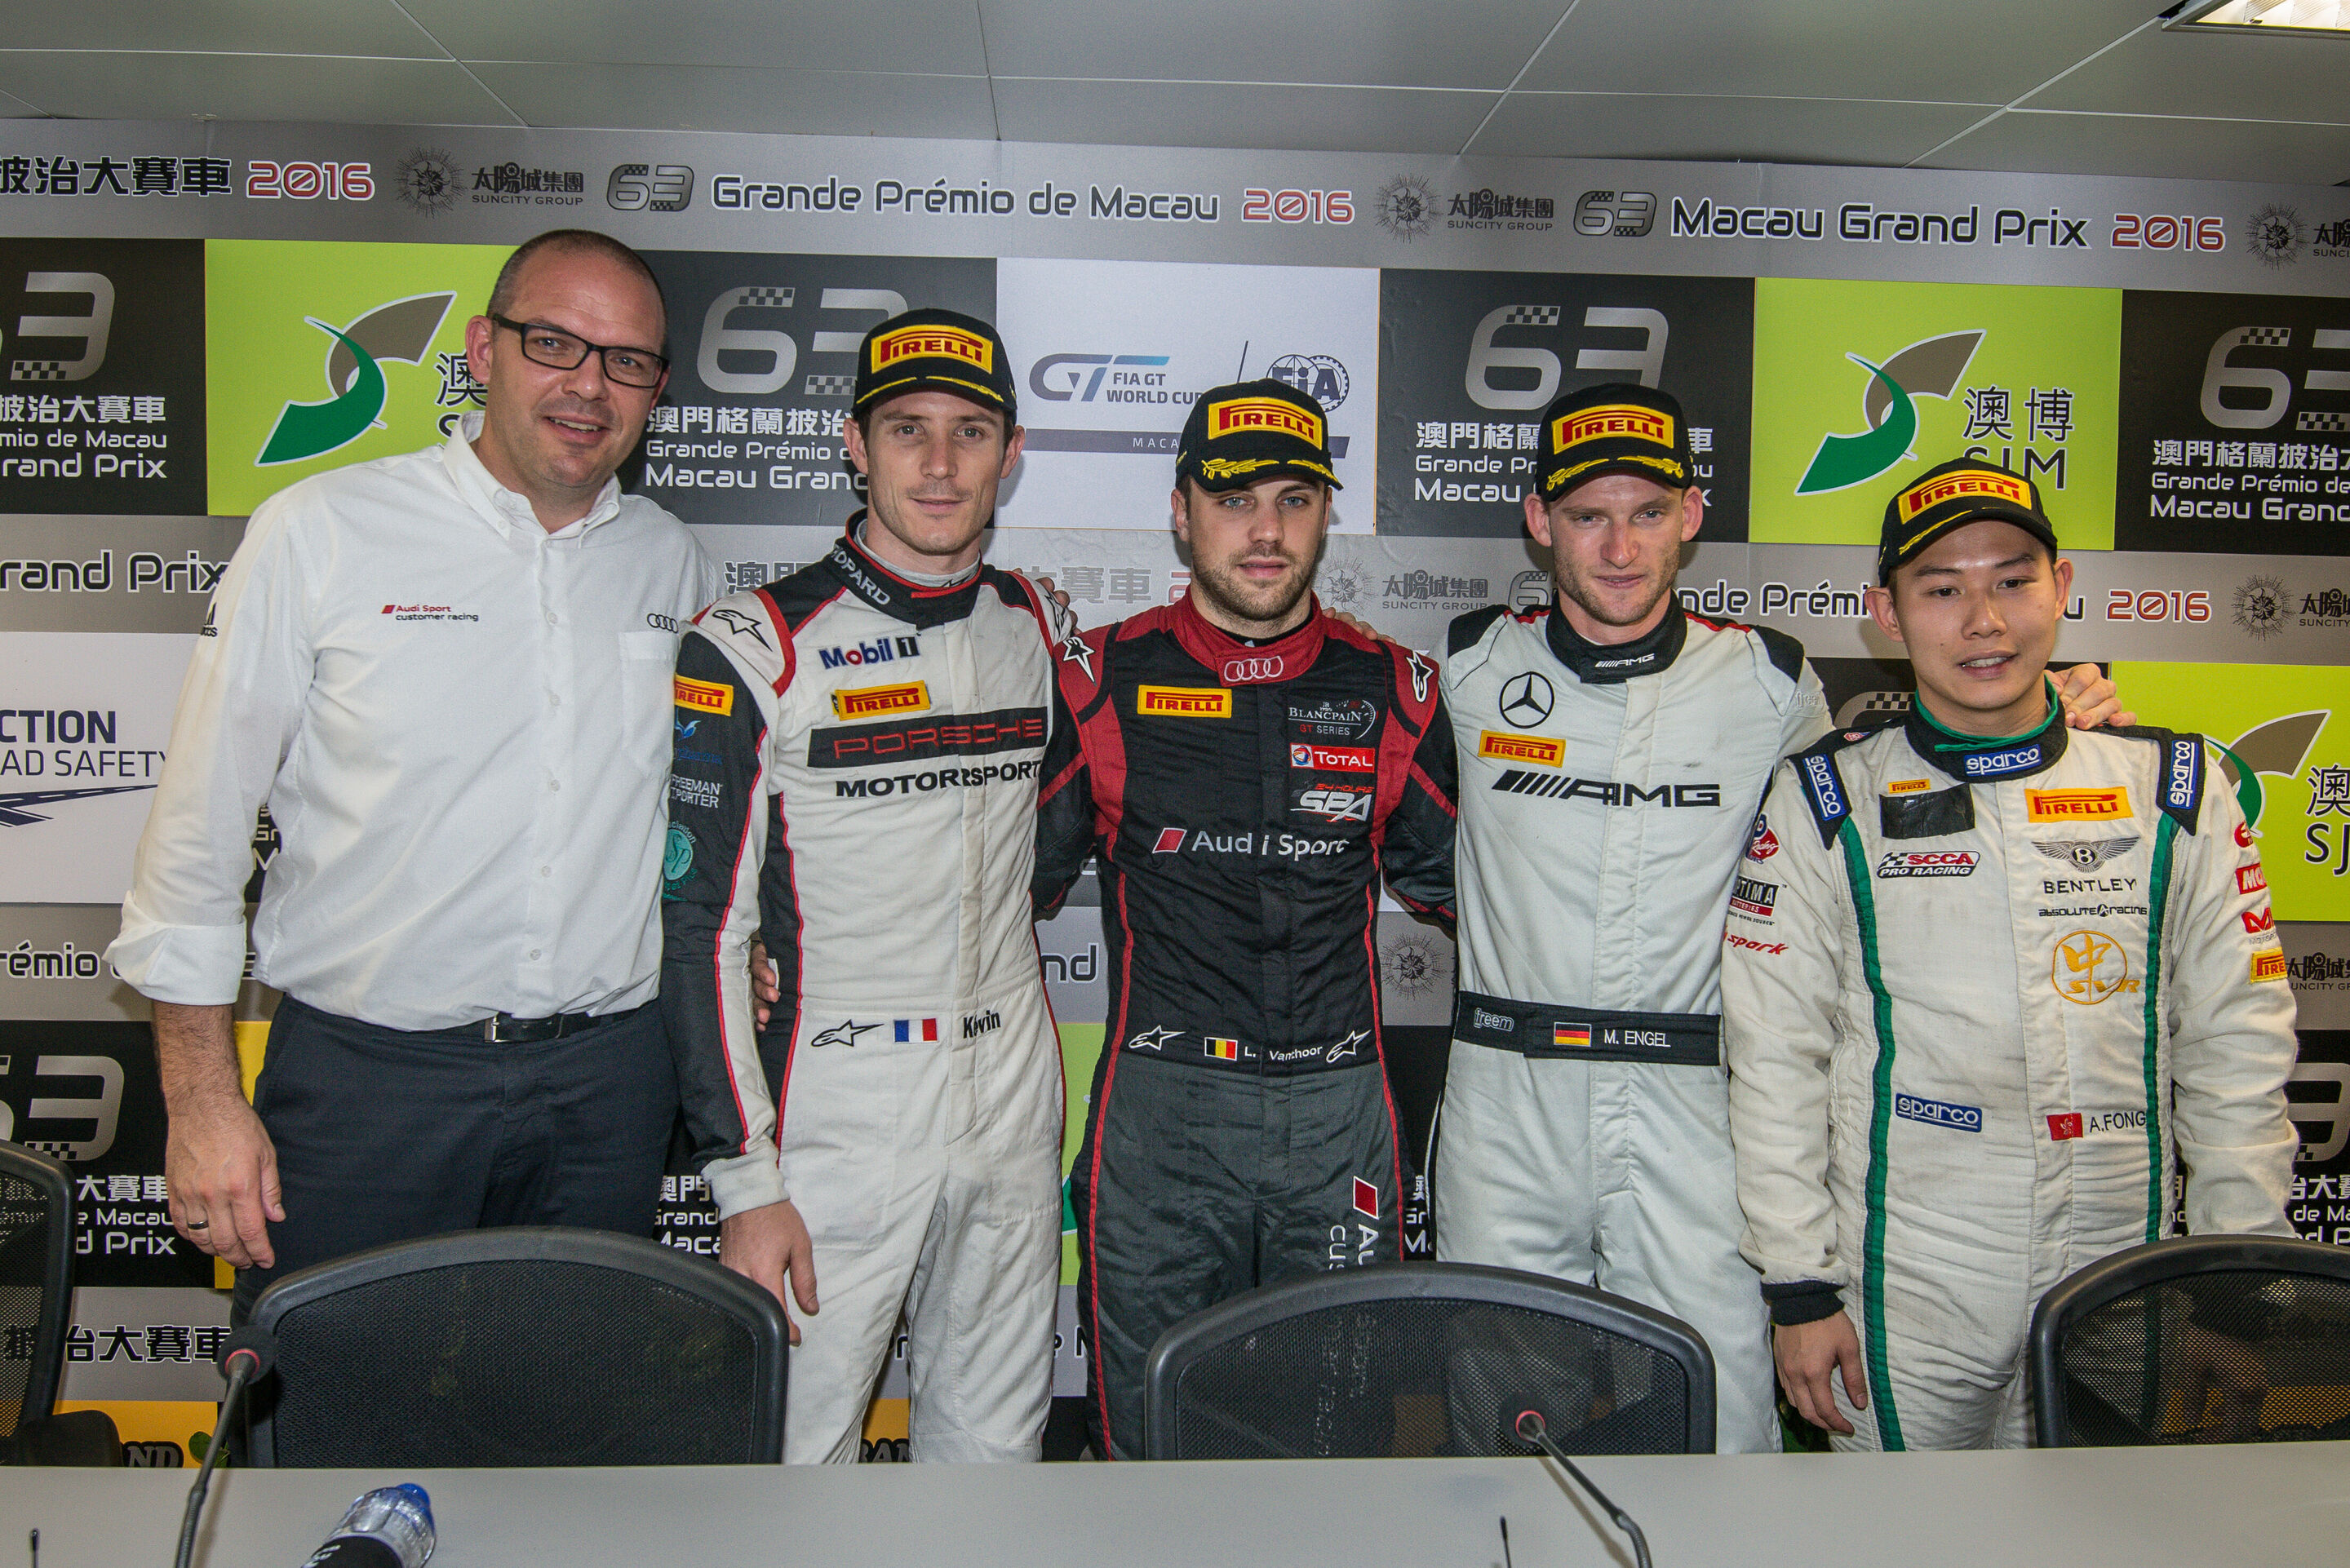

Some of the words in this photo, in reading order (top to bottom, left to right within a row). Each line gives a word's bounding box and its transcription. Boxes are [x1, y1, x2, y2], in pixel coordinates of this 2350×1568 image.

[246, 162, 375, 201] 2016
[606, 164, 694, 212] 63
[472, 195, 531, 206] SUNCITY
[535, 196, 584, 206] GROUP
[712, 175, 862, 214] Grande
[875, 177, 1015, 215] Prémio
[1028, 181, 1077, 218] de
[1090, 185, 1221, 222] Macau
[1242, 188, 1355, 224] 2016
[1448, 220, 1503, 230] SUNCITY
[1507, 221, 1554, 231] GROUP
[1573, 190, 1656, 237] 63
[1671, 196, 1825, 240] Macau
[1839, 202, 1979, 243] Grand
[1993, 207, 2091, 250] Prix
[2110, 213, 2226, 252] 2016
[880, 328, 984, 364] PIRELLI
[1113, 372, 1143, 386] FIA
[1145, 373, 1166, 386] GT
[1106, 390, 1168, 404] WORLD
[1219, 403, 1315, 440] PIRELLI
[1562, 410, 1665, 445] PIRELLI
[47, 428, 78, 447] de
[86, 429, 167, 448] Macau
[646, 440, 738, 458] Grande
[746, 441, 831, 460] Prémio
[95, 453, 167, 478] Prix
[645, 463, 756, 488] Macau
[1415, 454, 1502, 473] Grande
[1414, 477, 1521, 503] Macau
[1909, 474, 2020, 513] PIRELLI
[2152, 472, 2234, 491] Grande
[2241, 474, 2318, 494] Prémio
[2149, 494, 2250, 520] Macau
[127, 550, 230, 593] Prix
[423, 605, 451, 613] Sport
[448, 613, 479, 622] racing
[1382, 600, 1439, 610] SUNCITY
[1443, 601, 1487, 610] GROUP
[2105, 588, 2212, 623] 2016
[819, 638, 893, 670] Mobil
[845, 688, 920, 713] PIRELLI
[1146, 691, 1223, 712] PIRELLI
[1288, 707, 1363, 721] BLANCPAIN
[834, 718, 1043, 760] PORSCHE
[1300, 724, 1314, 733] GT
[1316, 725, 1350, 735] SERIES
[1315, 751, 1373, 767] TOTAL
[1485, 735, 1558, 760] PIRELLI
[1966, 747, 2040, 774] sparco
[1807, 755, 1842, 817] sparco
[2170, 742, 2195, 806] sparco
[2034, 794, 2118, 815] PIRELLI
[1278, 833, 1350, 862] Sport
[1908, 853, 1975, 866] SCCA
[1880, 867, 1909, 877] PRO
[1911, 866, 1971, 876] RACING
[2043, 879, 2137, 893] BENTLEY
[1244, 1046, 1257, 1057] L.
[1604, 1030, 1619, 1045] M.
[1625, 1030, 1672, 1048] ENGEL
[1898, 1096, 1979, 1131] sparco
[2089, 1110, 2147, 1132] A.FONG
[2294, 1205, 2320, 1222] de
[105, 1230, 176, 1255] Prix
